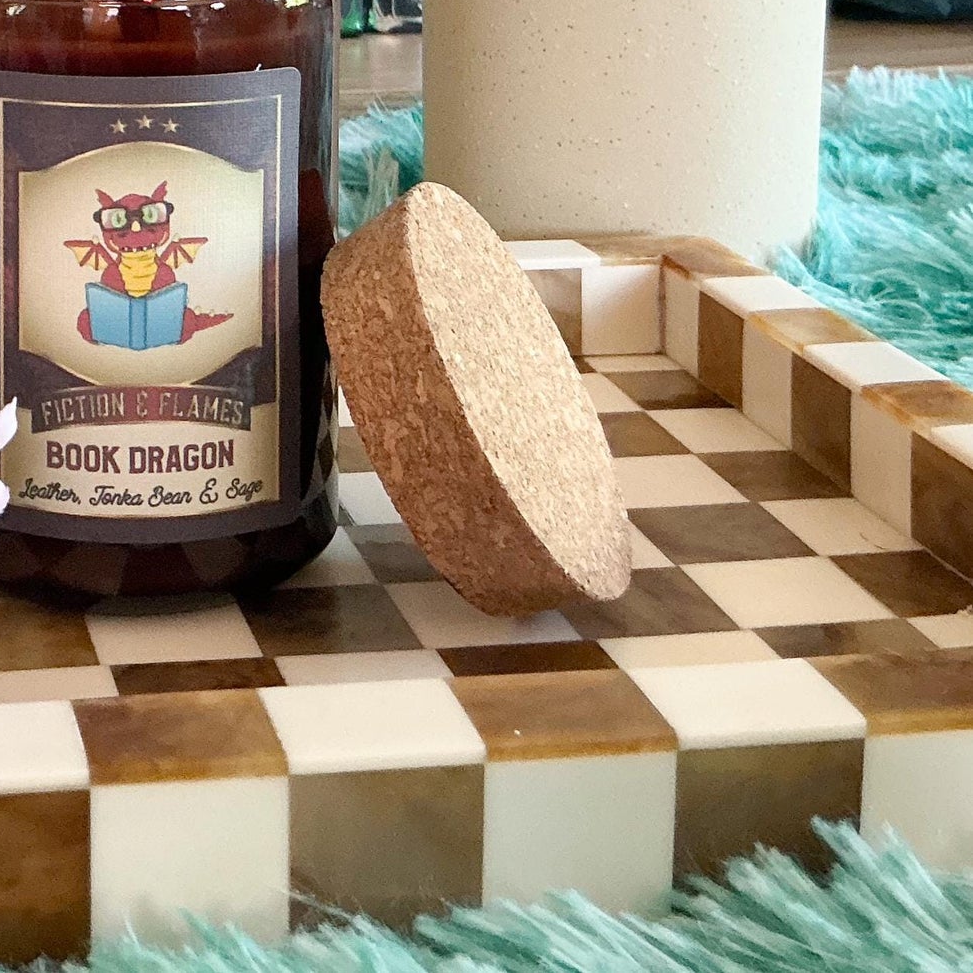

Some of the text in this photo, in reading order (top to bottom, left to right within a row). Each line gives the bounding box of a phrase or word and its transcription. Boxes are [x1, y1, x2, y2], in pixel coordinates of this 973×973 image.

[40, 390, 244, 426] FICTION & FLAMES
[45, 439, 234, 474] BOOK DRAGON
[18, 477, 264, 507] Leather, Tonka Bean & Sage
